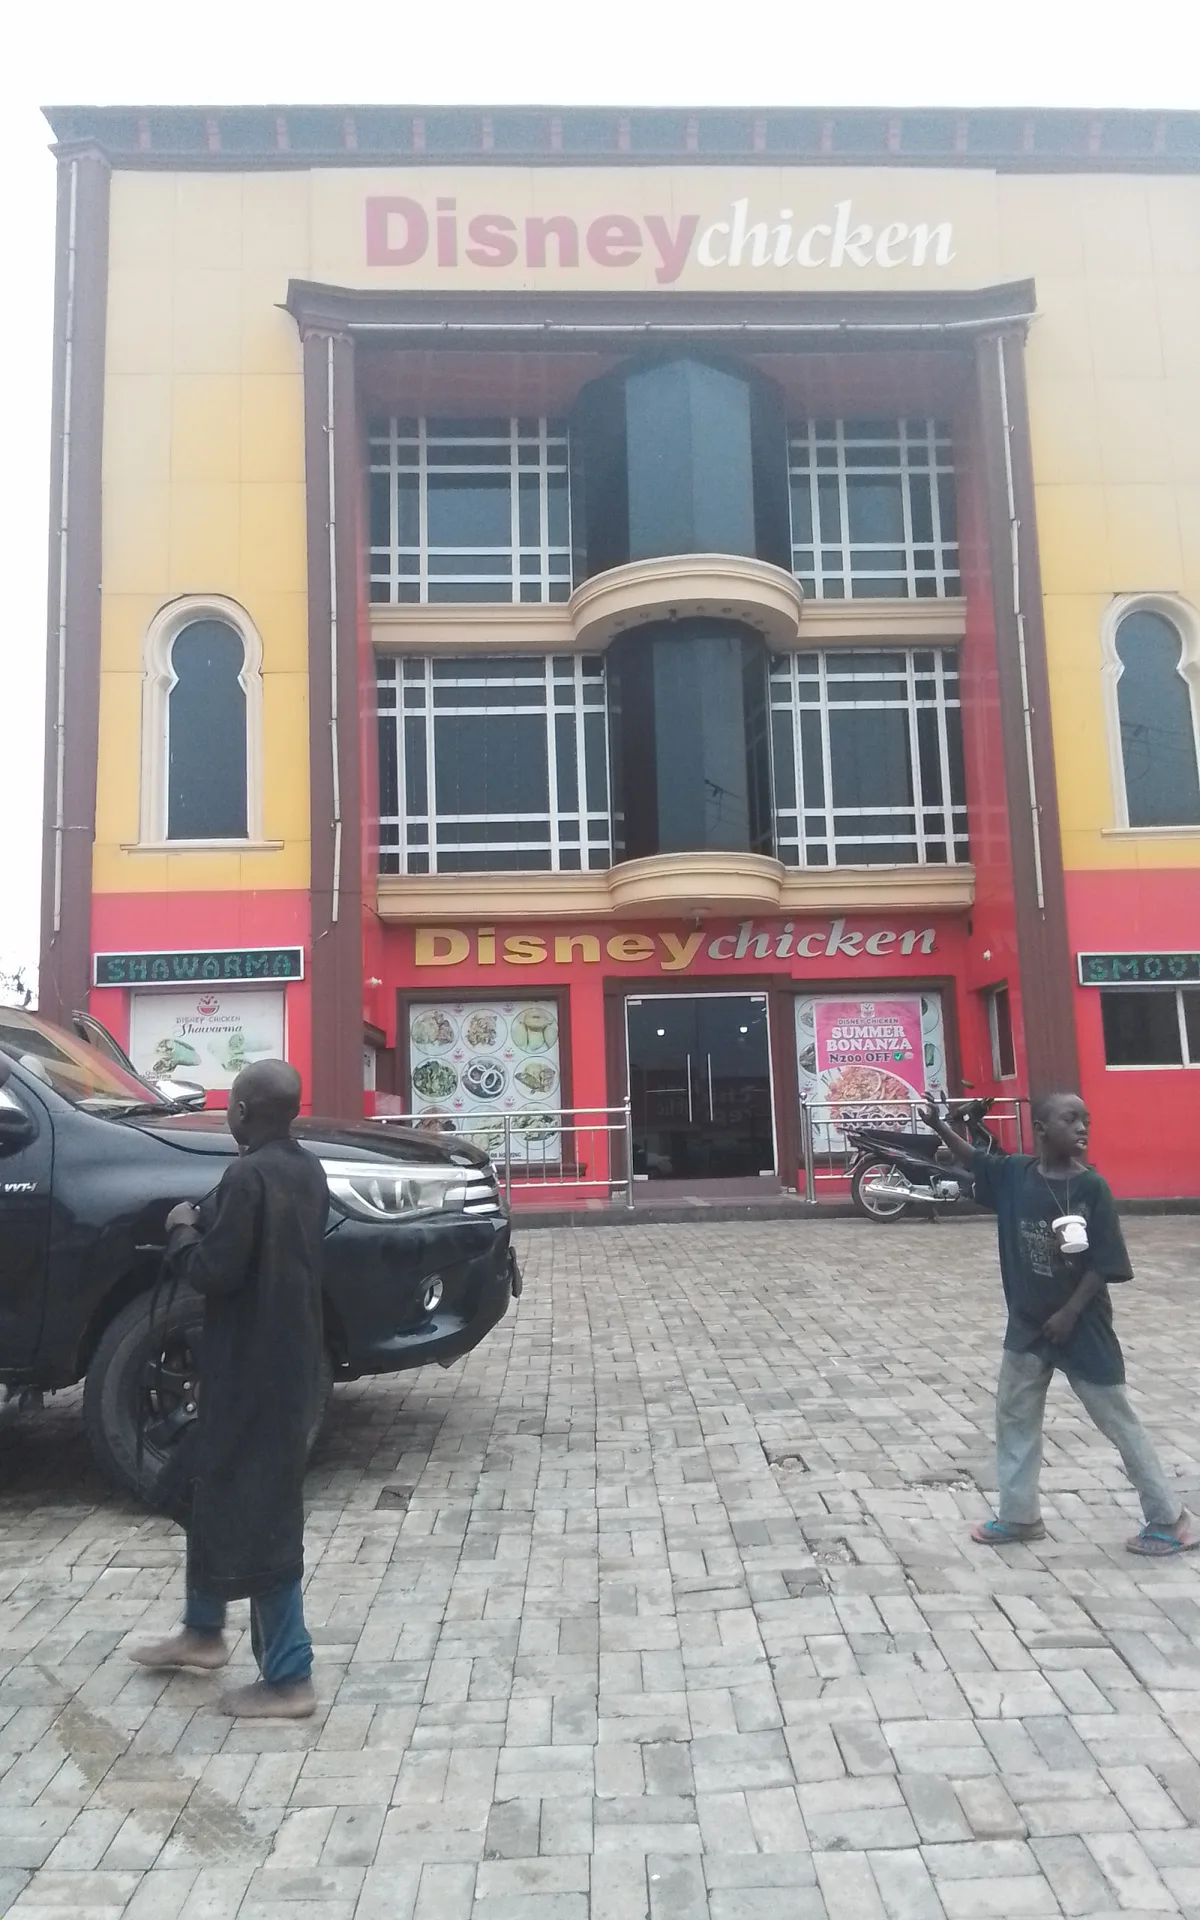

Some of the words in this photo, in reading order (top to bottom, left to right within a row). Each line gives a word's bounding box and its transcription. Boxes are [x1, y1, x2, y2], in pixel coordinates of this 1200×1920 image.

[365, 196, 700, 284] Disney
[697, 198, 955, 268] chicken
[415, 927, 706, 971] Disney
[707, 918, 938, 960] chicken
[107, 954, 292, 982] SHAWARMA
[176, 1016, 205, 1024] DISNEY
[208, 1015, 241, 1023] CHICKEN
[173, 1023, 242, 1037] Shawarma
[831, 1026, 906, 1039] SUMMER
[826, 1038, 912, 1052] BONANZA
[829, 1053, 862, 1063] N200
[865, 1052, 891, 1062] OFF
